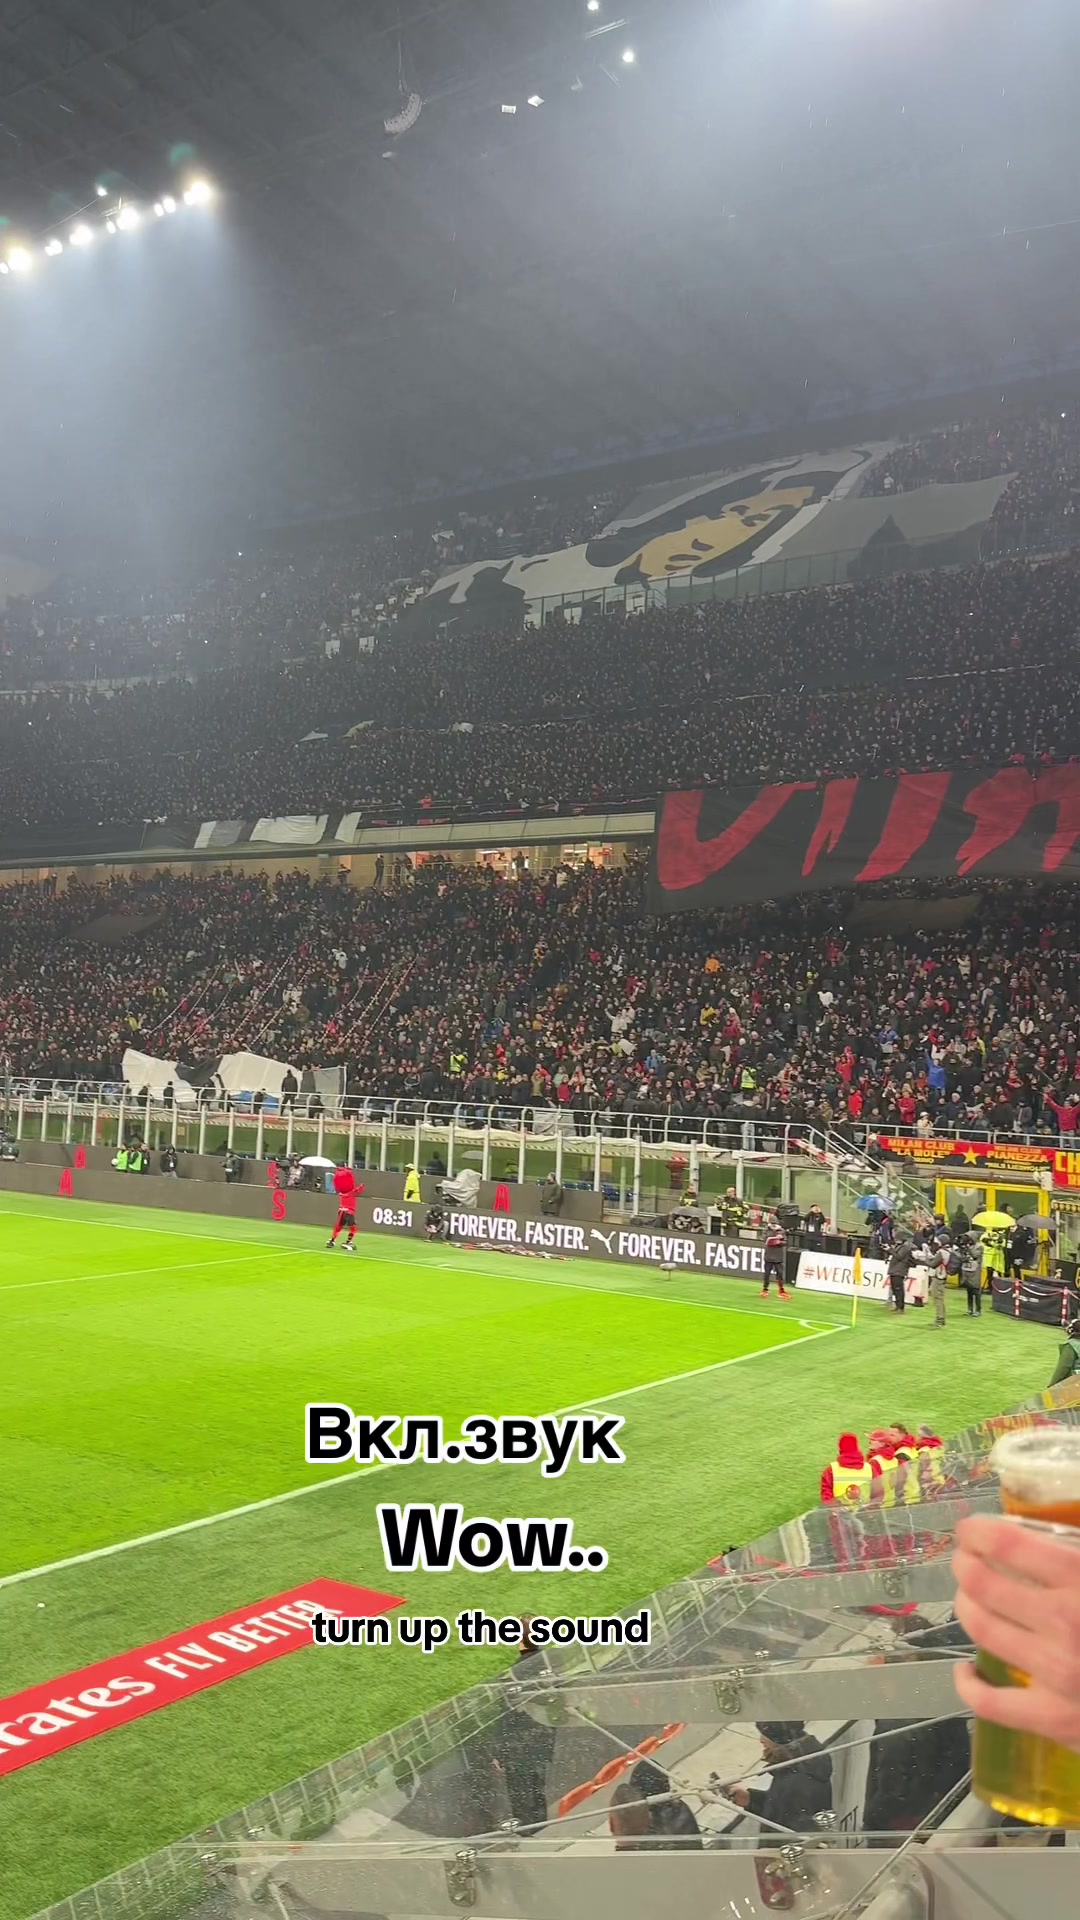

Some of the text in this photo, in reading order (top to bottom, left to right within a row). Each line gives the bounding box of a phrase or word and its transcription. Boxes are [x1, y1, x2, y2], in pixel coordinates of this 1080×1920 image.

[888, 1138, 955, 1151] MILAN CLUB
[986, 1150, 1048, 1163] PIANEZZA
[271, 1190, 287, 1222] S
[372, 1207, 413, 1228] 08:31
[450, 1212, 522, 1243] FOREVER.
[525, 1220, 590, 1250] FASTER.
[619, 1231, 701, 1265] FOREVER.
[803, 1264, 917, 1293] #WERSPAT
[0, 1599, 344, 1755] rates FLY BETTER
